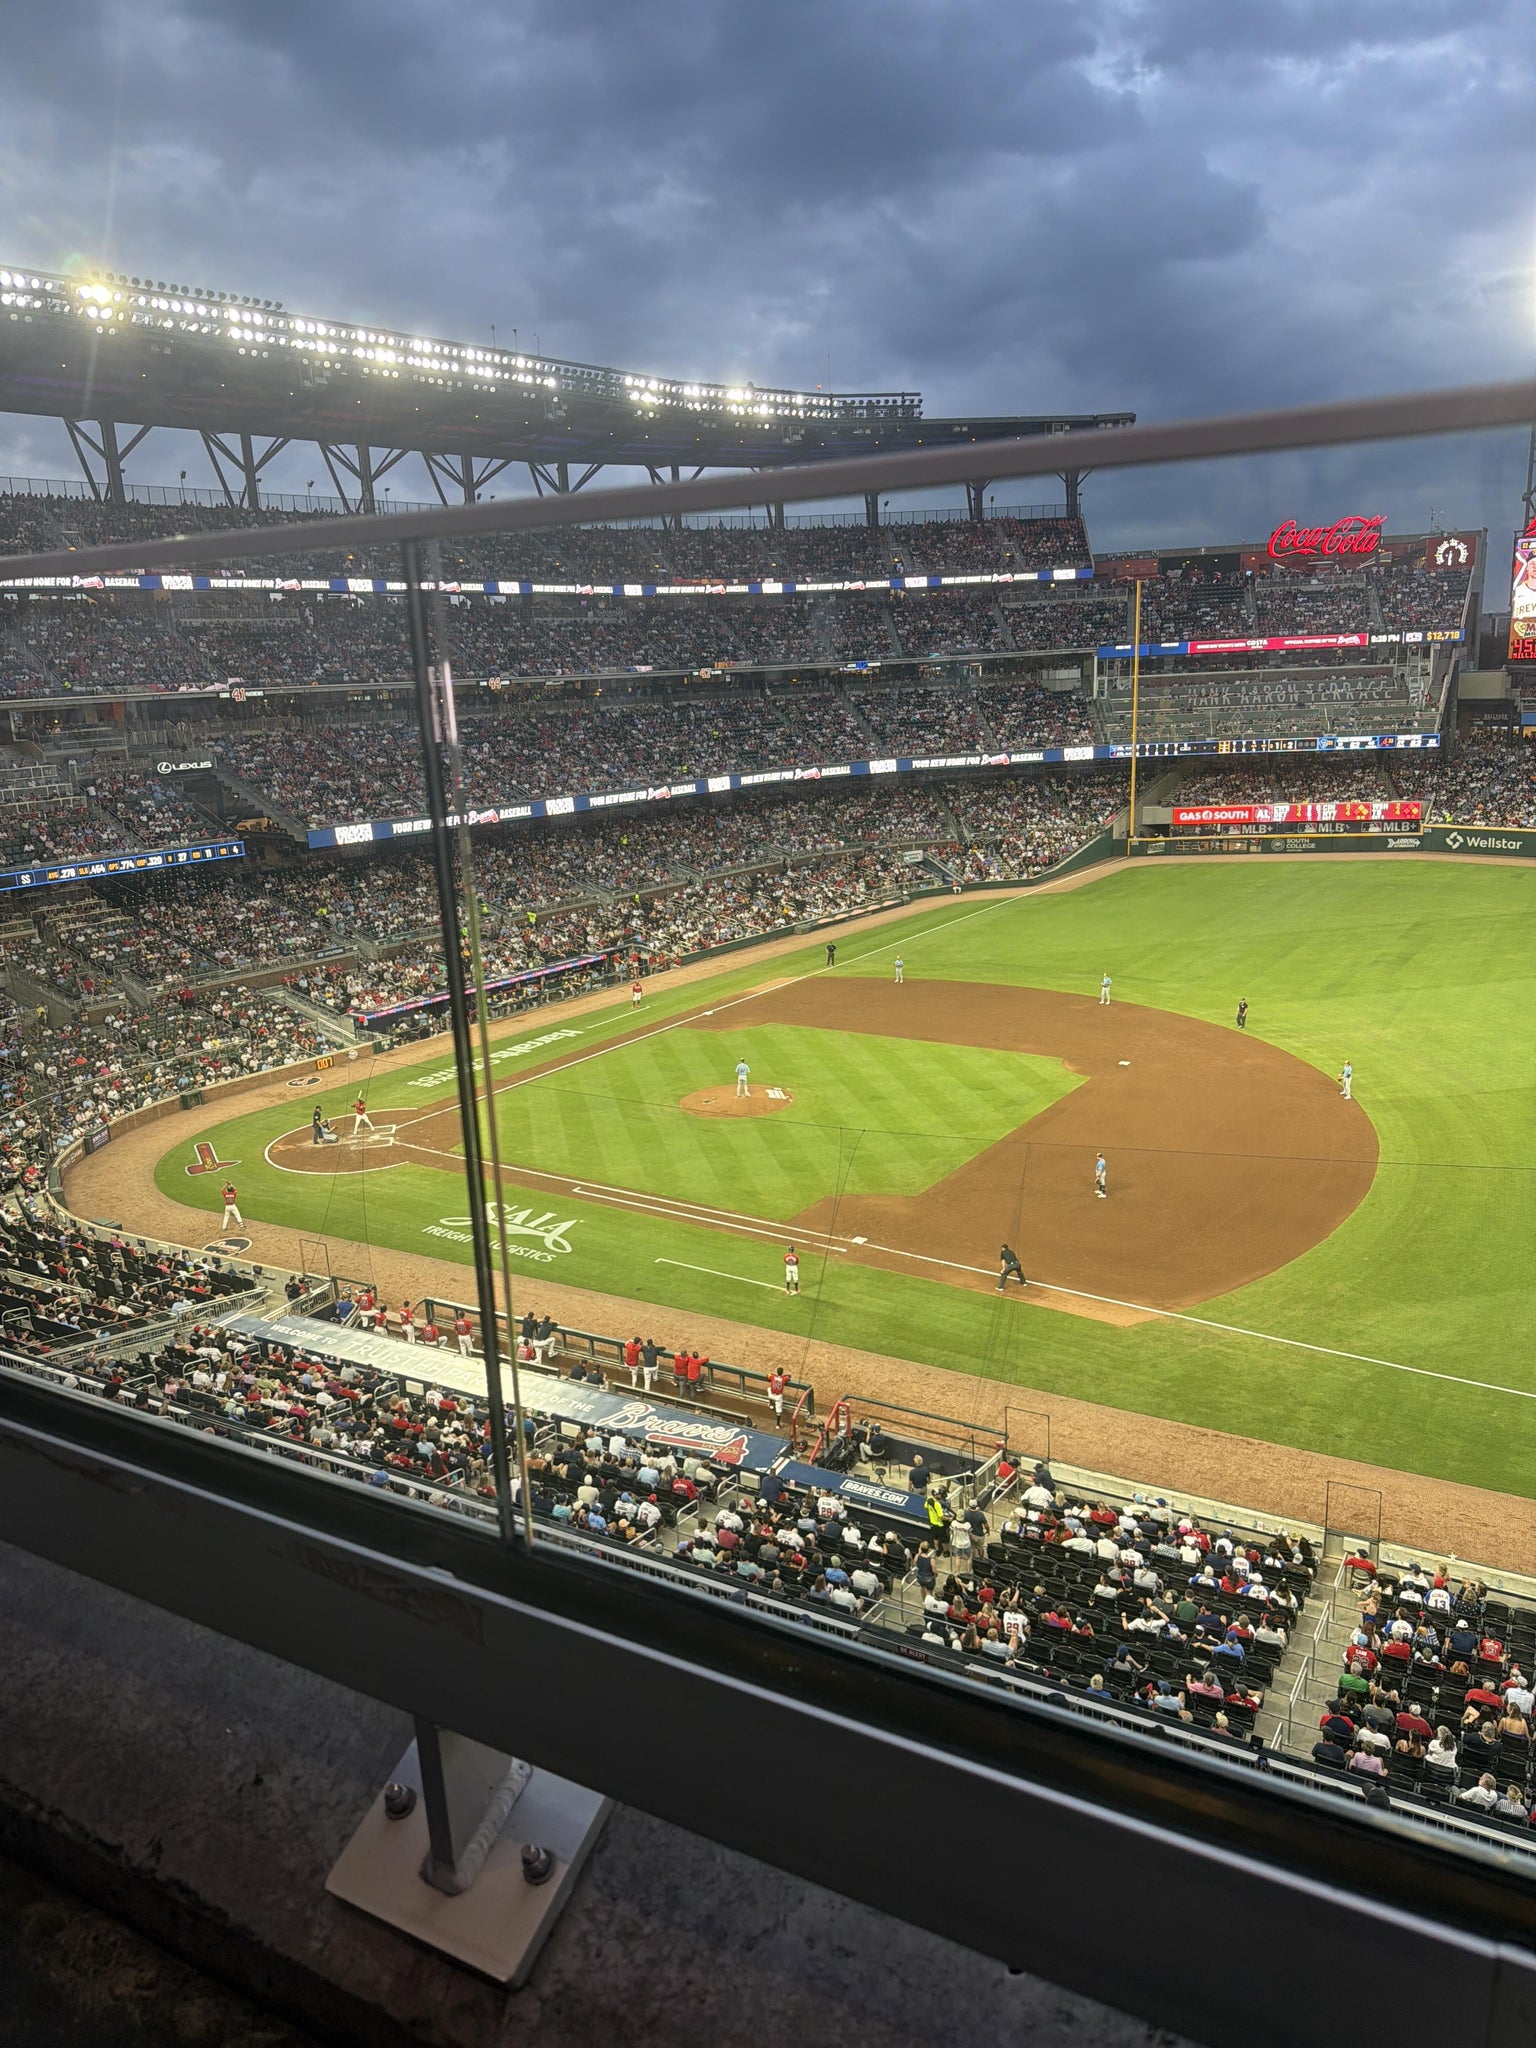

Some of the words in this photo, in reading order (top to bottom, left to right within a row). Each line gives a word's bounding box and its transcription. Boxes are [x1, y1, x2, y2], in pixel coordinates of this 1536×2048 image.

[1268, 515, 1387, 558] Coca-Cola
[13, 577, 33, 587] NEW
[33, 576, 56, 587] HOME
[56, 575, 71, 586] FOR
[105, 577, 140, 587] BASEBALL
[301, 580, 331, 589] BASEBALL
[1388, 634, 1400, 642] PM
[232, 687, 246, 702] 41
[1188, 684, 1231, 706] HANK
[1241, 682, 1299, 704] AARON
[1306, 680, 1392, 702] TERRACE
[1010, 752, 1043, 763] BASEBALL
[172, 761, 212, 771] LEXUS
[821, 766, 850, 776] BASEBALL
[671, 783, 696, 795] BASEBALL
[500, 805, 532, 819] BASEBALL
[1180, 811, 1201, 821] GAS
[1213, 810, 1248, 820] SOUTH
[1256, 809, 1271, 819] AL
[392, 821, 412, 835] YOUR
[1242, 825, 1273, 834] MLB+
[1383, 820, 1416, 831] MLB+
[1466, 836, 1523, 850] Wellstar
[232, 846, 239, 854] 4
[178, 852, 187, 861] 27
[20, 874, 31, 885] SS
[421, 1224, 474, 1243] FREIGHT
[270, 1323, 321, 1343] WELCOME
[321, 1336, 338, 1345] TO
[344, 1341, 415, 1368] TRUIST
[548, 1394, 563, 1404] OF
[568, 1399, 596, 1413] THE
[595, 1402, 740, 1442] Braves
[844, 1481, 904, 1505] BRAVES.COM
[821, 1506, 832, 1518] 28
[1434, 1599, 1446, 1610] 13
[1006, 1622, 1019, 1635] 29
